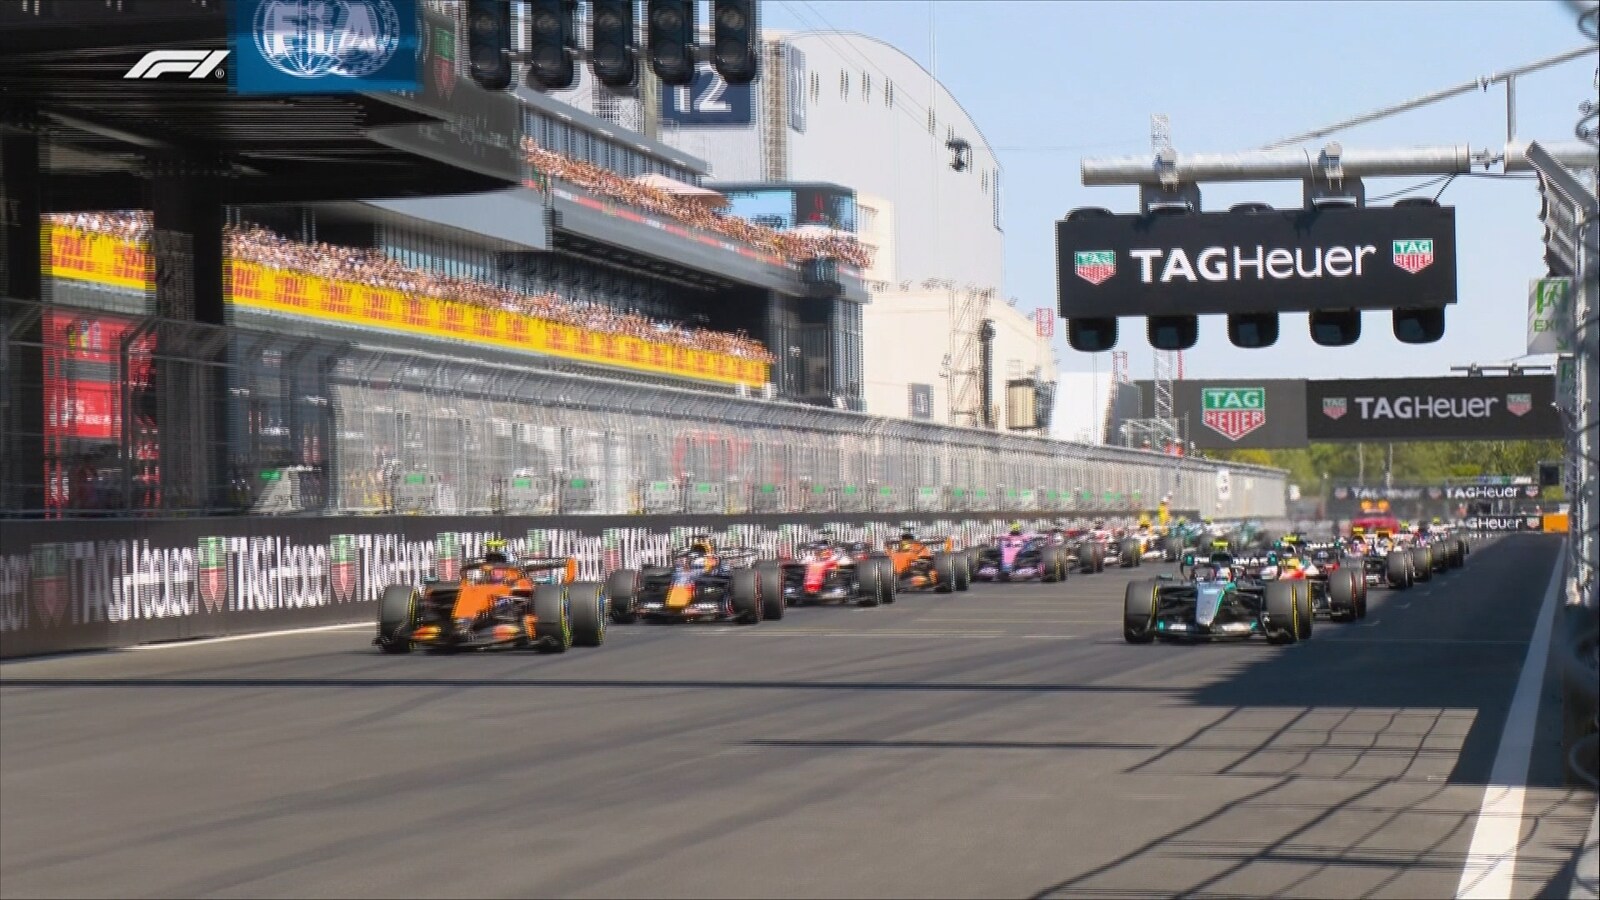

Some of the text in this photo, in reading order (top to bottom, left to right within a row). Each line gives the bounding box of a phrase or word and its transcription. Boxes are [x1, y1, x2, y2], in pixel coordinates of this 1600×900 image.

[1395, 241, 1430, 253] TAG
[1208, 392, 1259, 407] TAG
[1355, 396, 1499, 419] TAGHeuer
[1205, 411, 1263, 435] HEUER
